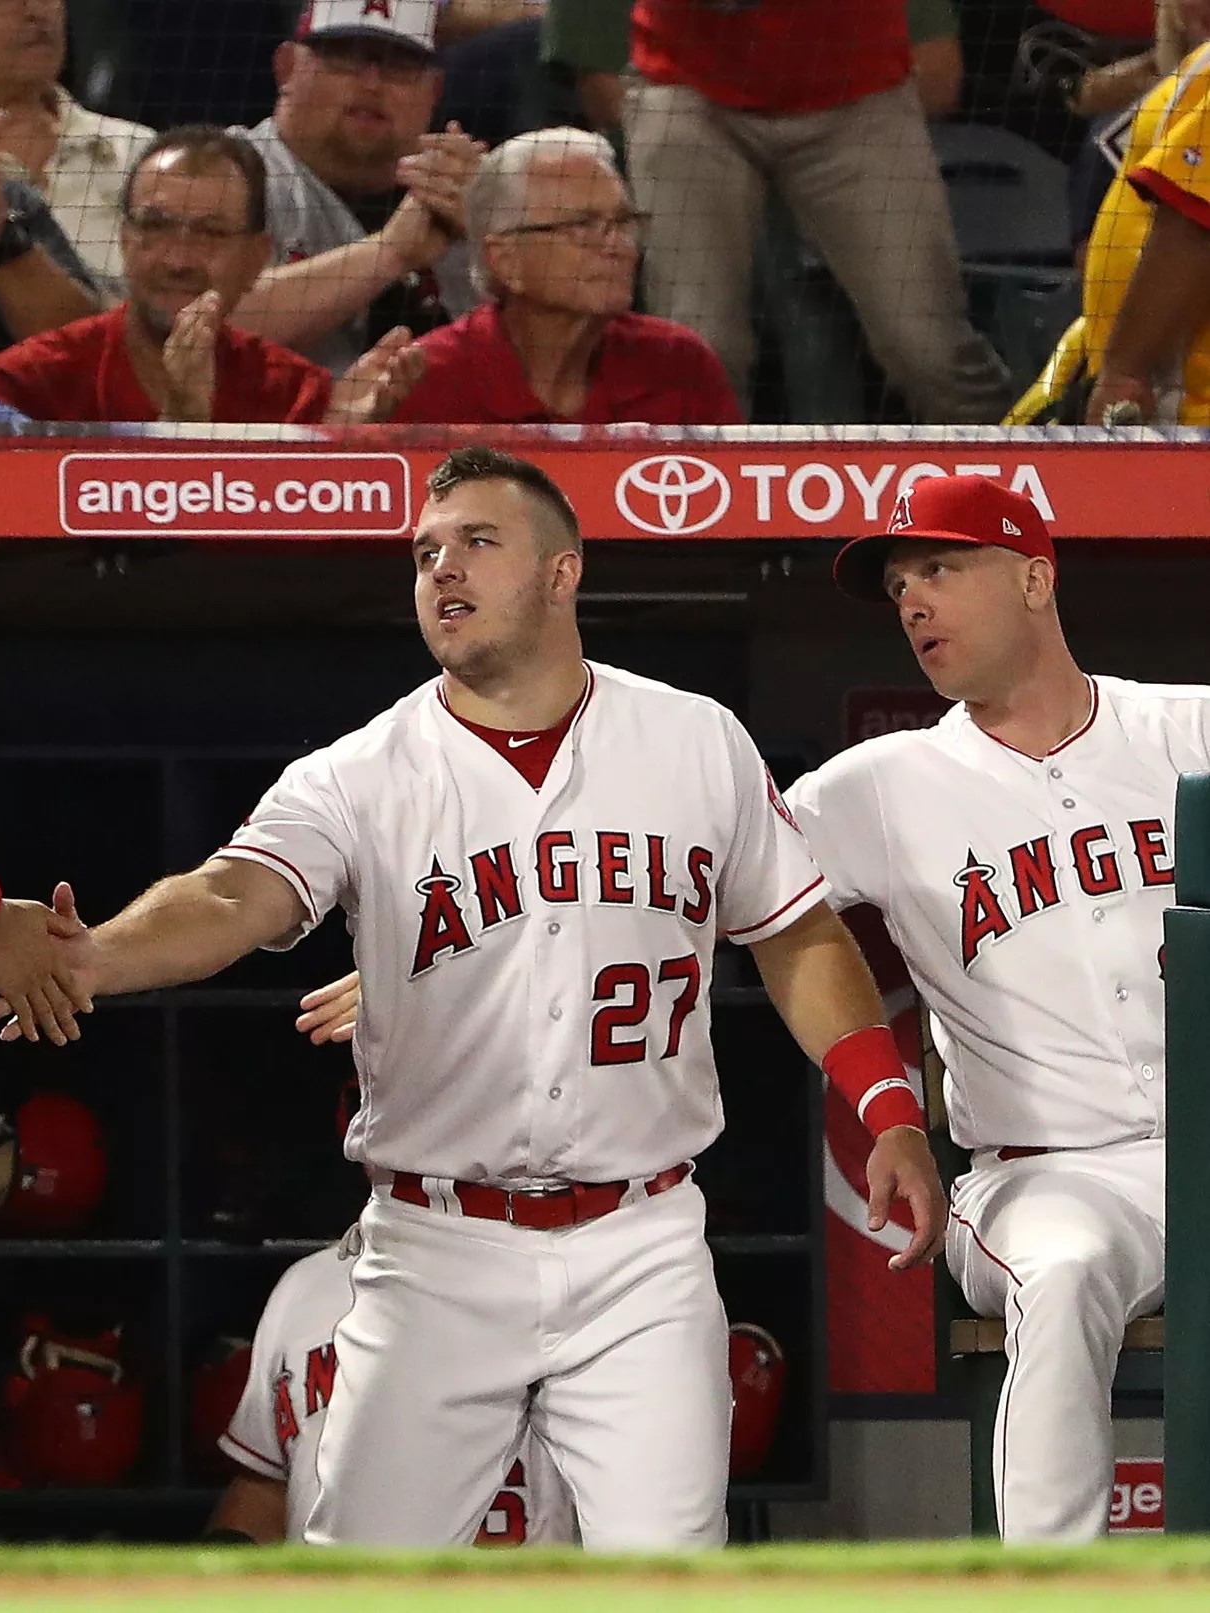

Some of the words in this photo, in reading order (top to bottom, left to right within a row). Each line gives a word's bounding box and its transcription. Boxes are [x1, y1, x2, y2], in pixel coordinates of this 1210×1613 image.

[78, 470, 392, 524] angels.com
[409, 830, 714, 978] ANGELS
[590, 952, 701, 1067] 27
